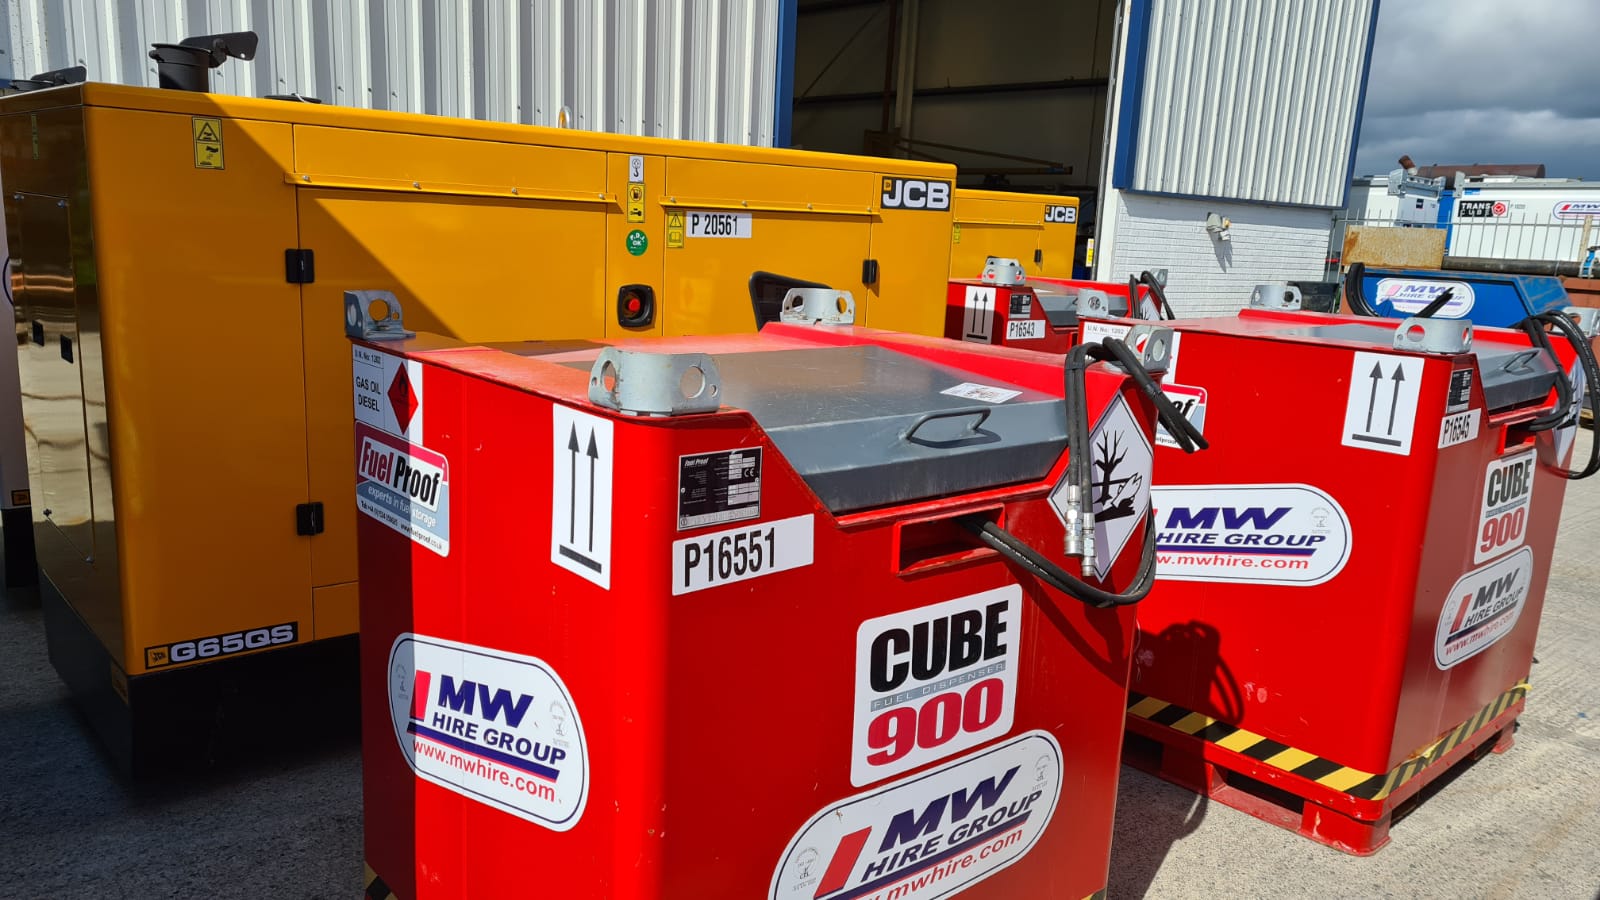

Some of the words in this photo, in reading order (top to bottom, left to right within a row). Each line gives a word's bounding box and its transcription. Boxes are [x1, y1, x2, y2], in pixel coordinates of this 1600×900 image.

[883, 180, 949, 209] JCB
[1045, 206, 1076, 222] JCB
[1461, 202, 1491, 210] TRANS
[692, 214, 700, 234] P
[704, 214, 738, 235] 20561
[1010, 323, 1035, 337] P16543
[355, 376, 369, 391] GAS
[370, 380, 381, 395] OIL
[357, 394, 380, 412] DIESEL
[1442, 414, 1471, 445] P16545
[361, 441, 394, 485] Fuel
[394, 456, 440, 506] Proof
[368, 485, 393, 505] experts
[1486, 458, 1533, 508] CUBE
[1156, 532, 1219, 545] HIRE
[1224, 533, 1326, 547] GROUP
[1164, 507, 1293, 530] MW
[1479, 506, 1525, 554] 900
[684, 527, 775, 588] P16551
[1156, 555, 1309, 570] w.mwhire.com
[1464, 604, 1493, 628] HIRE
[1492, 586, 1524, 613] GROUP
[1471, 567, 1521, 611] MW
[170, 624, 294, 662] G65QS
[869, 599, 1009, 693] CUBE
[437, 674, 534, 728] MW
[873, 693, 912, 709] FUEL
[922, 662, 1005, 695] DISPENSER
[432, 711, 479, 741] HIRE
[483, 728, 567, 765] GROUP
[866, 677, 1004, 767] 900
[413, 739, 556, 802] www.mwhire.com
[877, 764, 1022, 854] MW
[860, 834, 944, 883] HIRE
[947, 790, 1043, 846] GROUP
[874, 829, 1023, 900] mwhire.com
